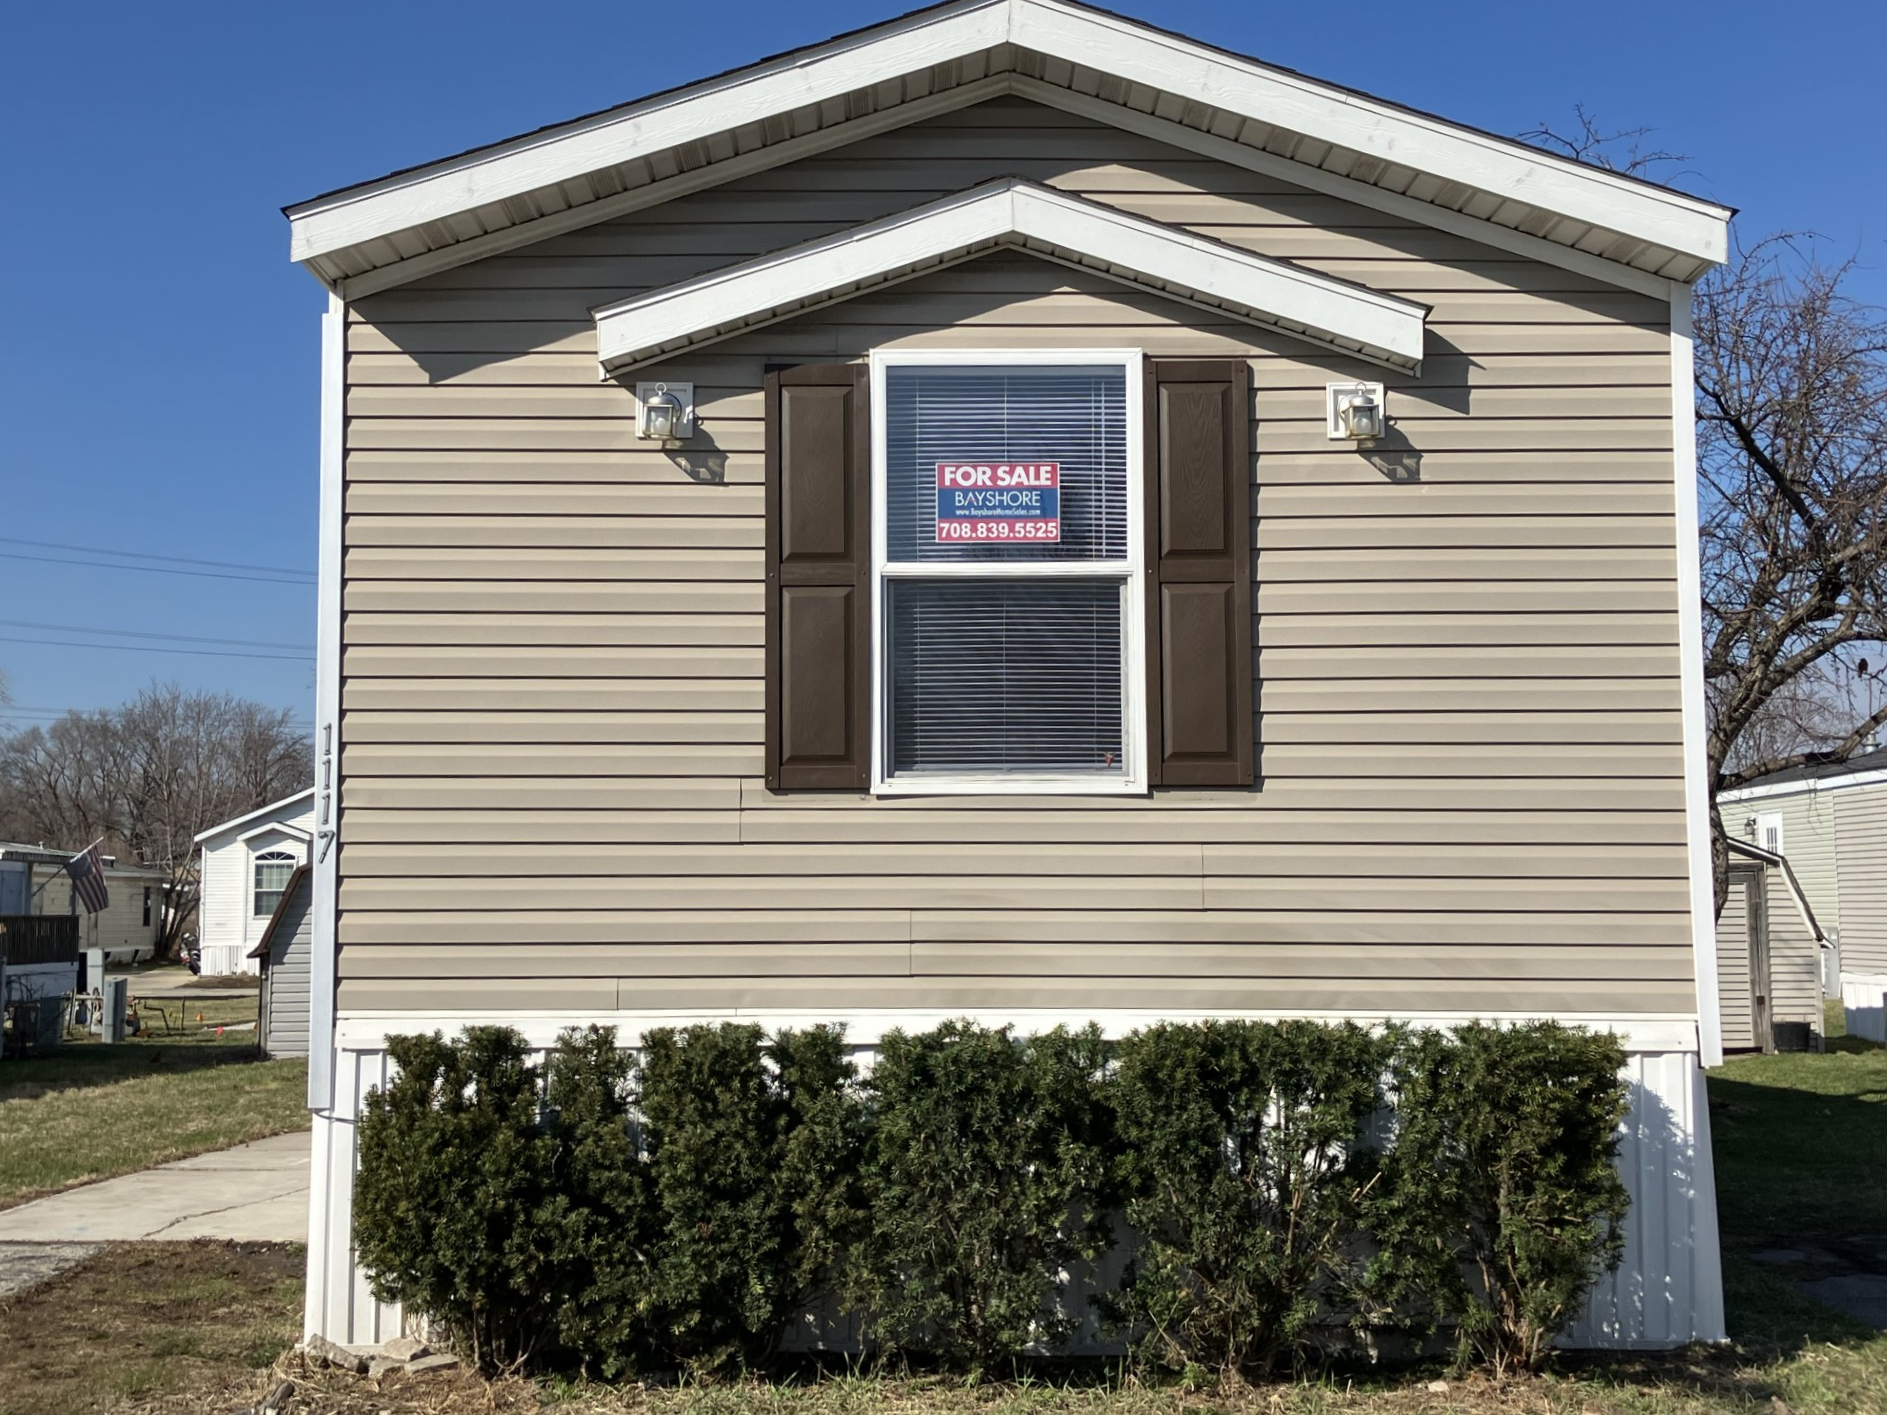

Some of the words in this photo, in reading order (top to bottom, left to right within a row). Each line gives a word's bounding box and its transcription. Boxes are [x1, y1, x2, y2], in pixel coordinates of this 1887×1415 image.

[944, 466, 993, 486] FOR
[996, 466, 1052, 486] SALE
[955, 491, 1041, 506] BAYSHORE
[939, 523, 1057, 538] 708.839.5525
[317, 723, 336, 864] 1117
